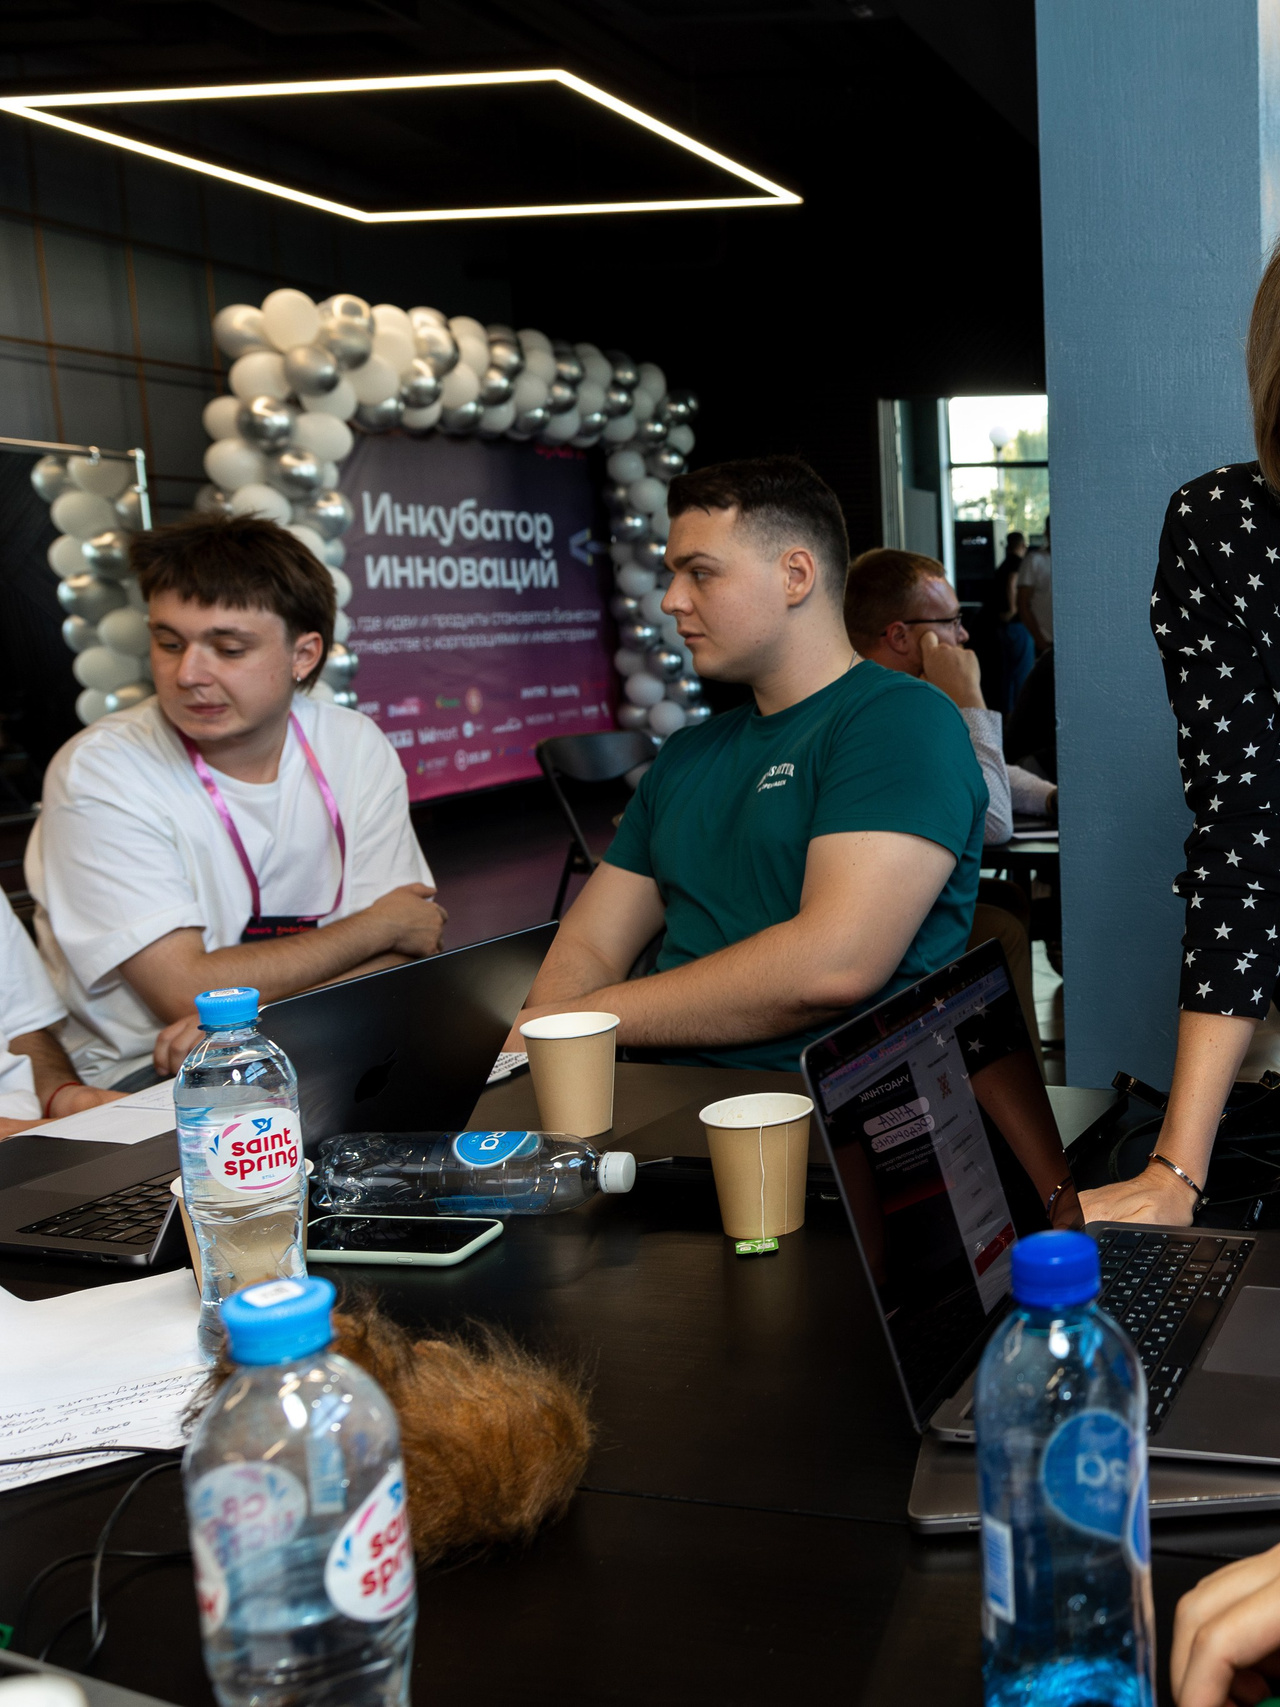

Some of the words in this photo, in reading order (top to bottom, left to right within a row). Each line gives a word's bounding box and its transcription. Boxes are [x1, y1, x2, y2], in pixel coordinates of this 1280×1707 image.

[362, 490, 554, 549] Инкубатор
[364, 547, 559, 594] инноваций
[223, 1143, 298, 1181] spring
[231, 1127, 292, 1157] saint
